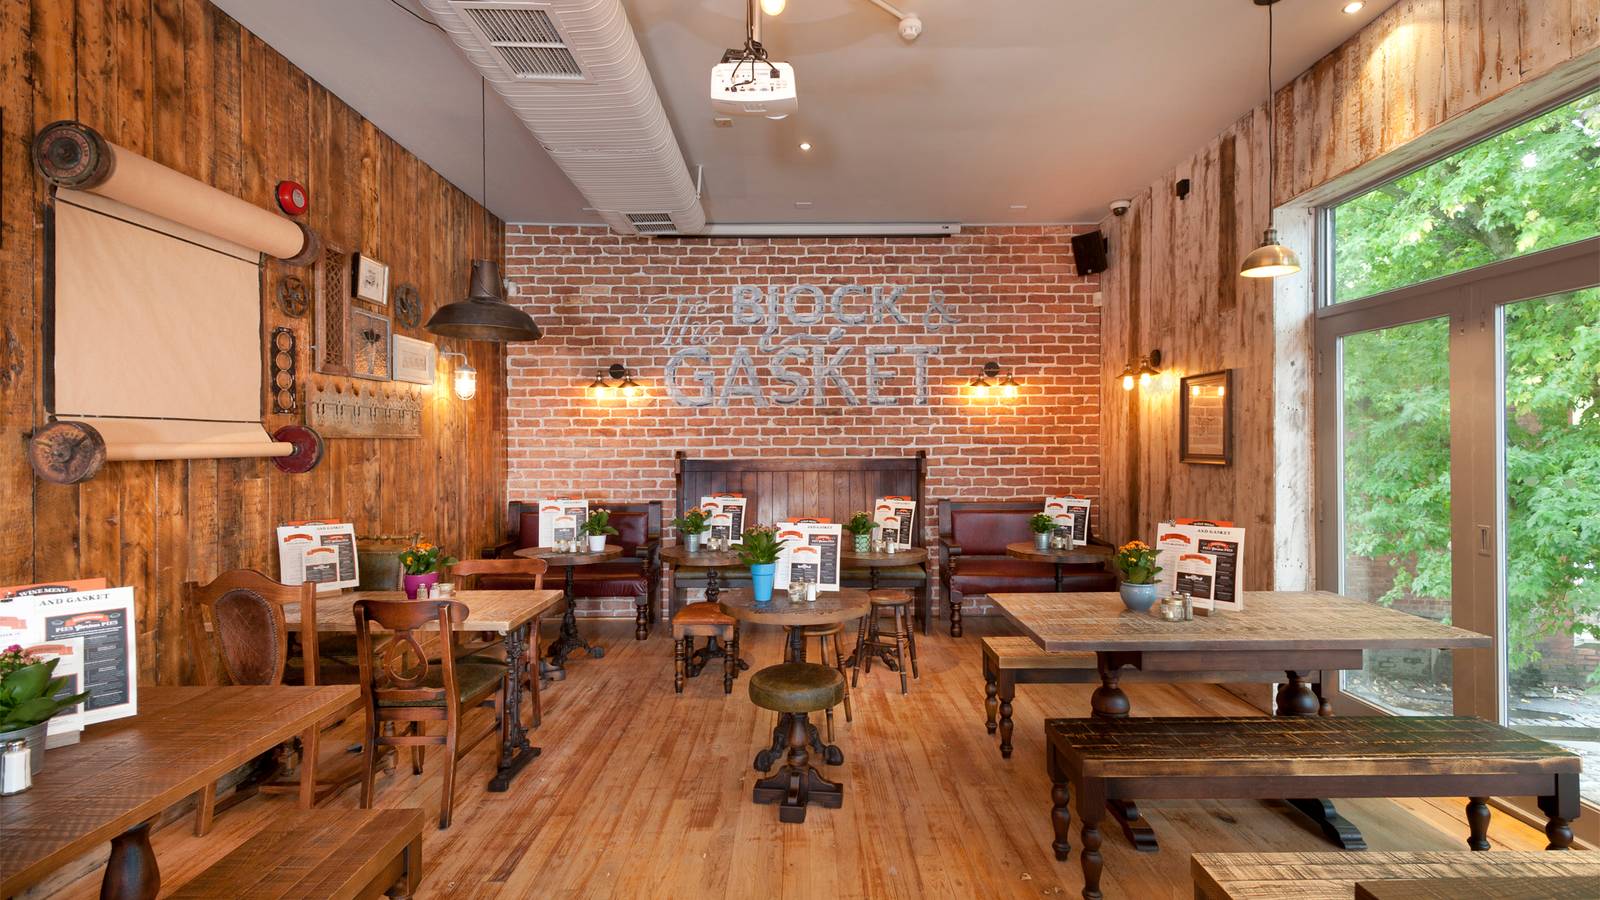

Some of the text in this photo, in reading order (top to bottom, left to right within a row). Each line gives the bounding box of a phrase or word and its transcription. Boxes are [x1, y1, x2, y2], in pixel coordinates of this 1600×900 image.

[643, 288, 724, 347] The
[923, 289, 961, 332] &
[664, 346, 940, 407] GASKET
[19, 588, 43, 597] WINE
[39, 593, 110, 607] AND GASKET
